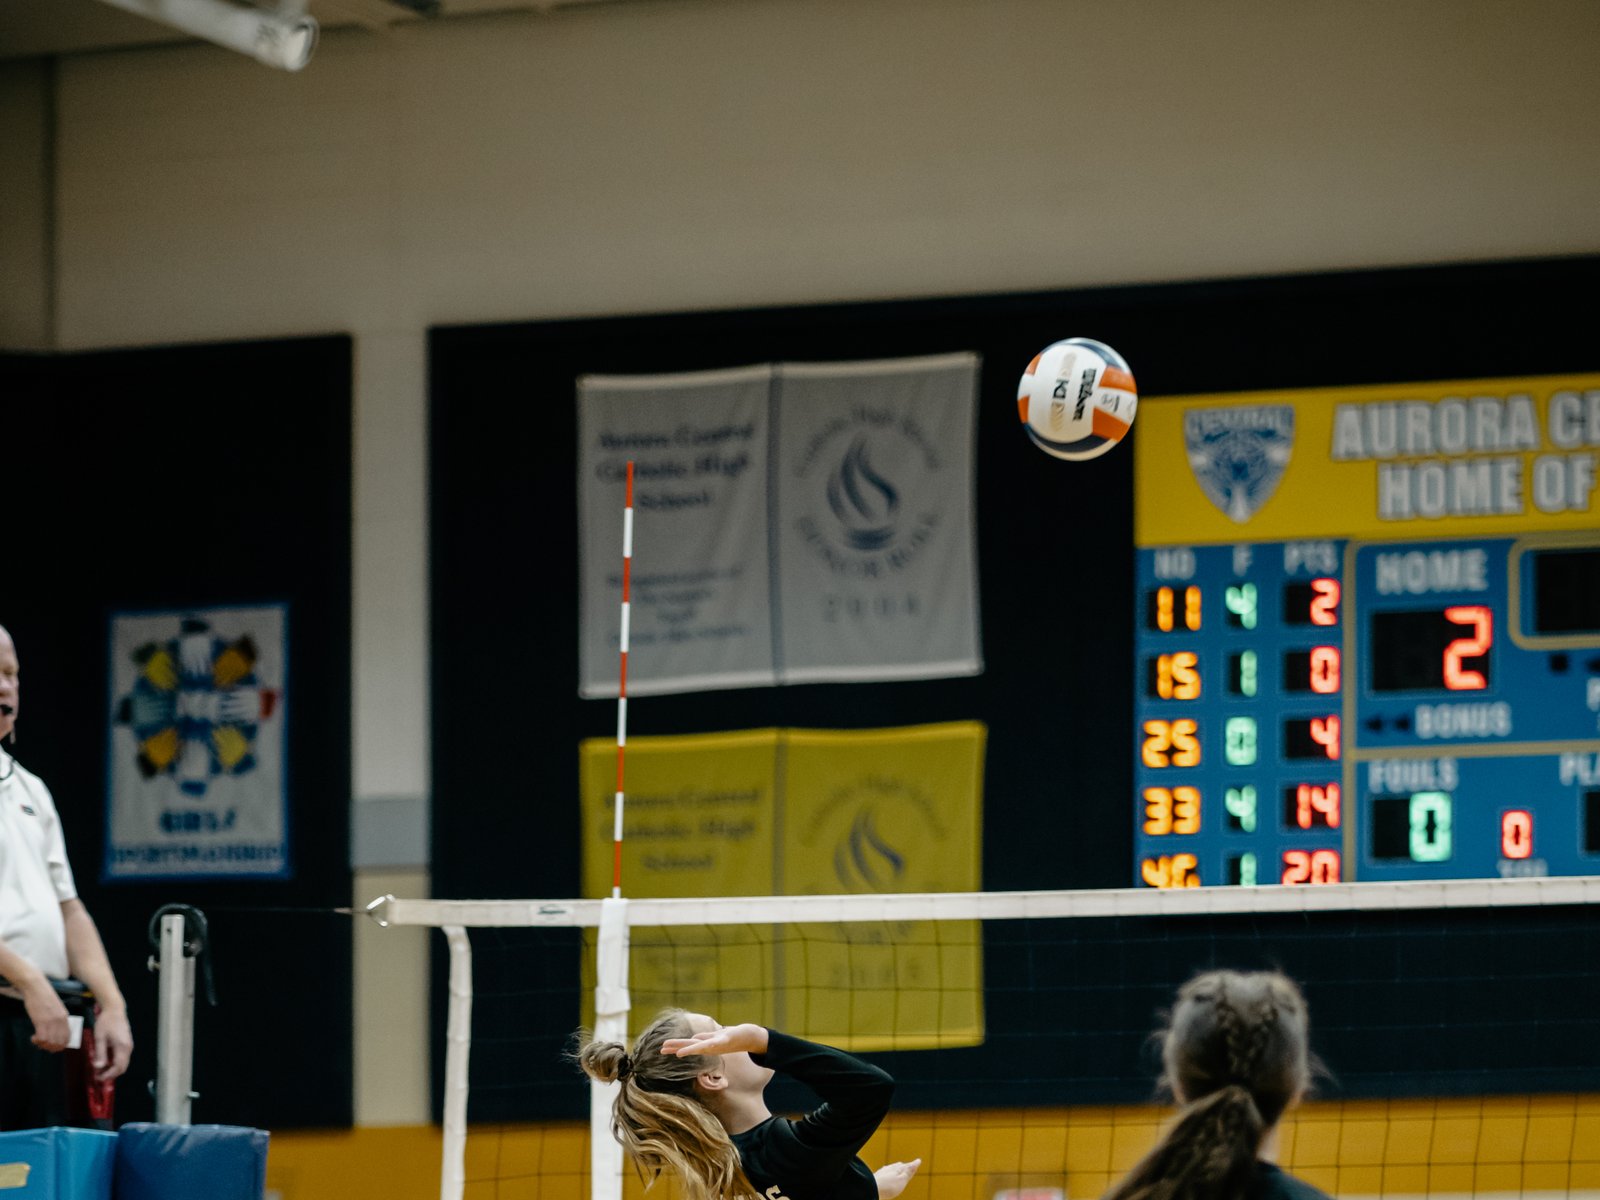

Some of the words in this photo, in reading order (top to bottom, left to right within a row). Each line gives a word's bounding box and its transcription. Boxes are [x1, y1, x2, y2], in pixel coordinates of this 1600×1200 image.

[1332, 393, 1541, 460] AURORA
[1376, 454, 1524, 521] HOME
[1531, 451, 1596, 514] OF
[1232, 544, 1252, 577] F
[1284, 541, 1338, 575] PTS
[1376, 548, 1489, 595] HOME
[1156, 585, 1201, 632] 11
[1225, 582, 1257, 630] 4
[1309, 577, 1341, 626] 2
[1310, 645, 1341, 694] 0
[1442, 605, 1493, 690] 2
[1157, 651, 1201, 700] 15
[1240, 650, 1257, 697] 1
[1142, 718, 1201, 768] 25
[1225, 716, 1257, 766] 0
[1309, 714, 1341, 760] 4
[1415, 701, 1512, 740] BONUS
[1368, 756, 1459, 794] FOULS
[1143, 785, 1201, 835] 33
[1225, 784, 1257, 833] 4
[1296, 782, 1341, 829] 14
[1409, 791, 1452, 862] 0
[1502, 810, 1533, 859] 0
